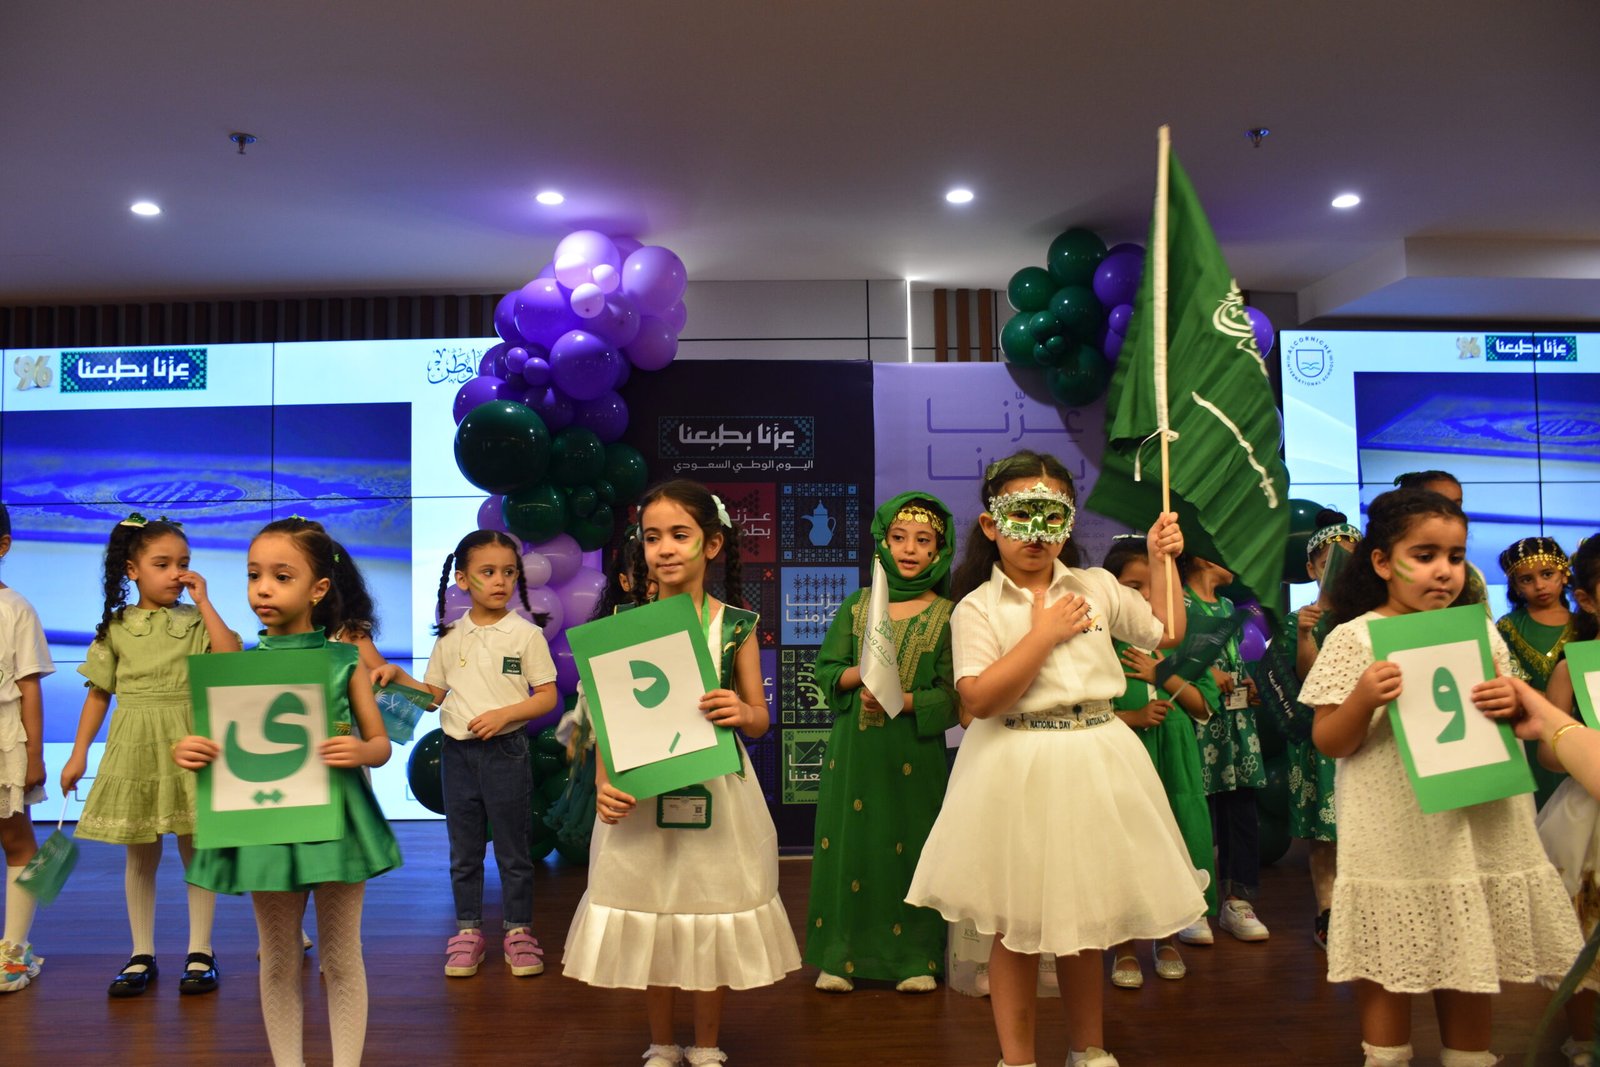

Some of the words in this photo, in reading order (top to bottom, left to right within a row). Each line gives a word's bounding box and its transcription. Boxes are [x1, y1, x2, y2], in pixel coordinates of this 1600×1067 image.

[1495, 339, 1541, 358] بطبعنا
[78, 357, 148, 385] بطبعنا
[678, 423, 752, 451] بطبعنا
[673, 460, 731, 473] السعودي
[775, 460, 814, 471] اليوم
[1432, 666, 1467, 744] و
[1029, 720, 1058, 730] NATIONAL
[1059, 720, 1071, 730] DAY
[225, 691, 309, 805] ي
